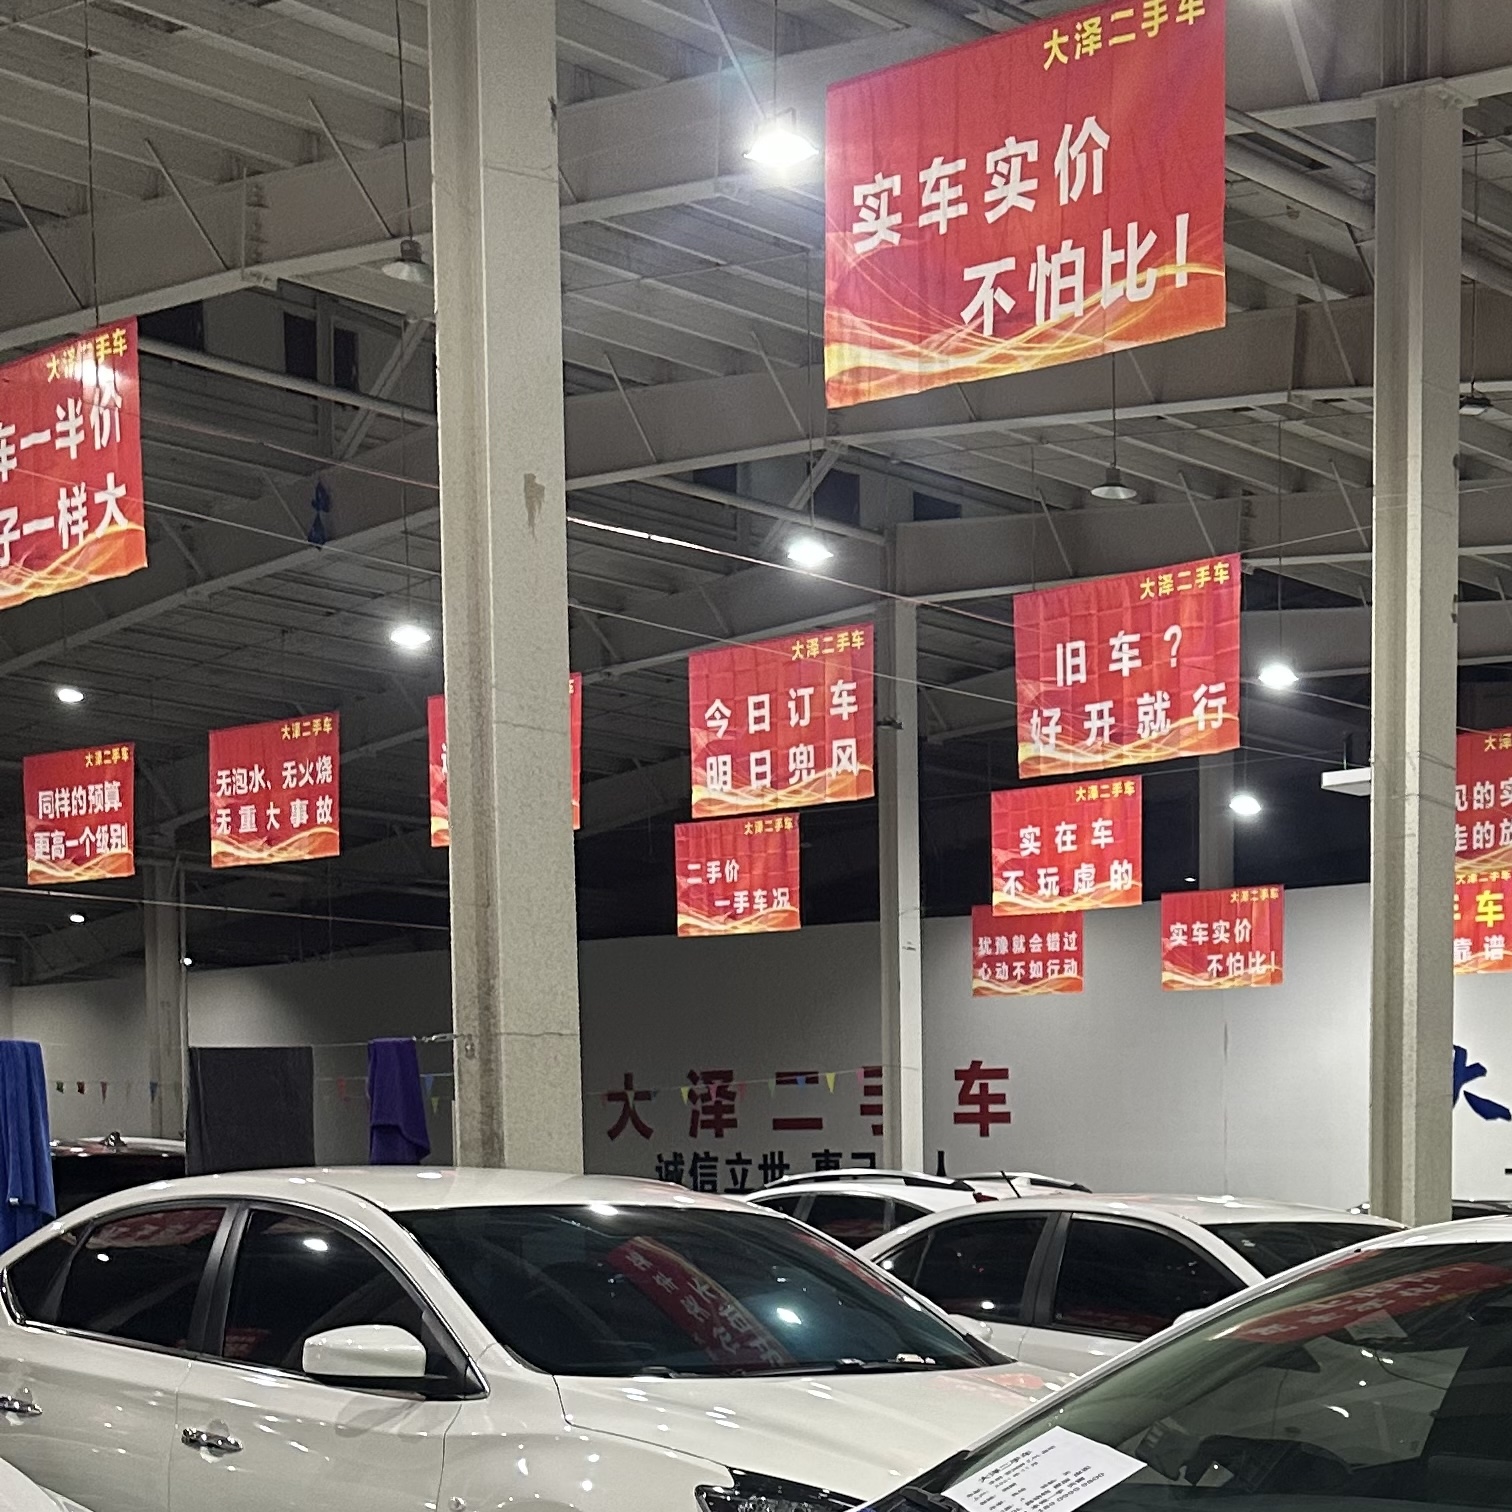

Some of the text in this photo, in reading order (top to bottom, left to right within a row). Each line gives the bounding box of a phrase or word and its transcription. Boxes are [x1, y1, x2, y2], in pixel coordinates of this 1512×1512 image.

[1043, 0, 1205, 70] 大泽二手车
[852, 115, 1110, 254] 实车实价
[960, 213, 1189, 336] 不怕比！
[1139, 561, 1230, 600] 大泽二手车
[791, 630, 865, 660] 大泽二手车
[1056, 624, 1183, 687] 旧车？
[705, 680, 859, 738] 今日订车
[1030, 682, 1227, 751] 好开就行
[706, 738, 859, 793] 明日兜风
[38, 781, 122, 819] 同样的预算
[1075, 781, 1136, 802] 大泽二手车
[216, 795, 333, 835] 无重大事故
[34, 822, 128, 860] 更高一个级别
[1019, 817, 1114, 857] 实在车
[687, 859, 740, 884] 二手价
[1002, 859, 1133, 899] 不玩虚的
[715, 888, 791, 914] 一手车况
[1169, 918, 1252, 947] 实车实价
